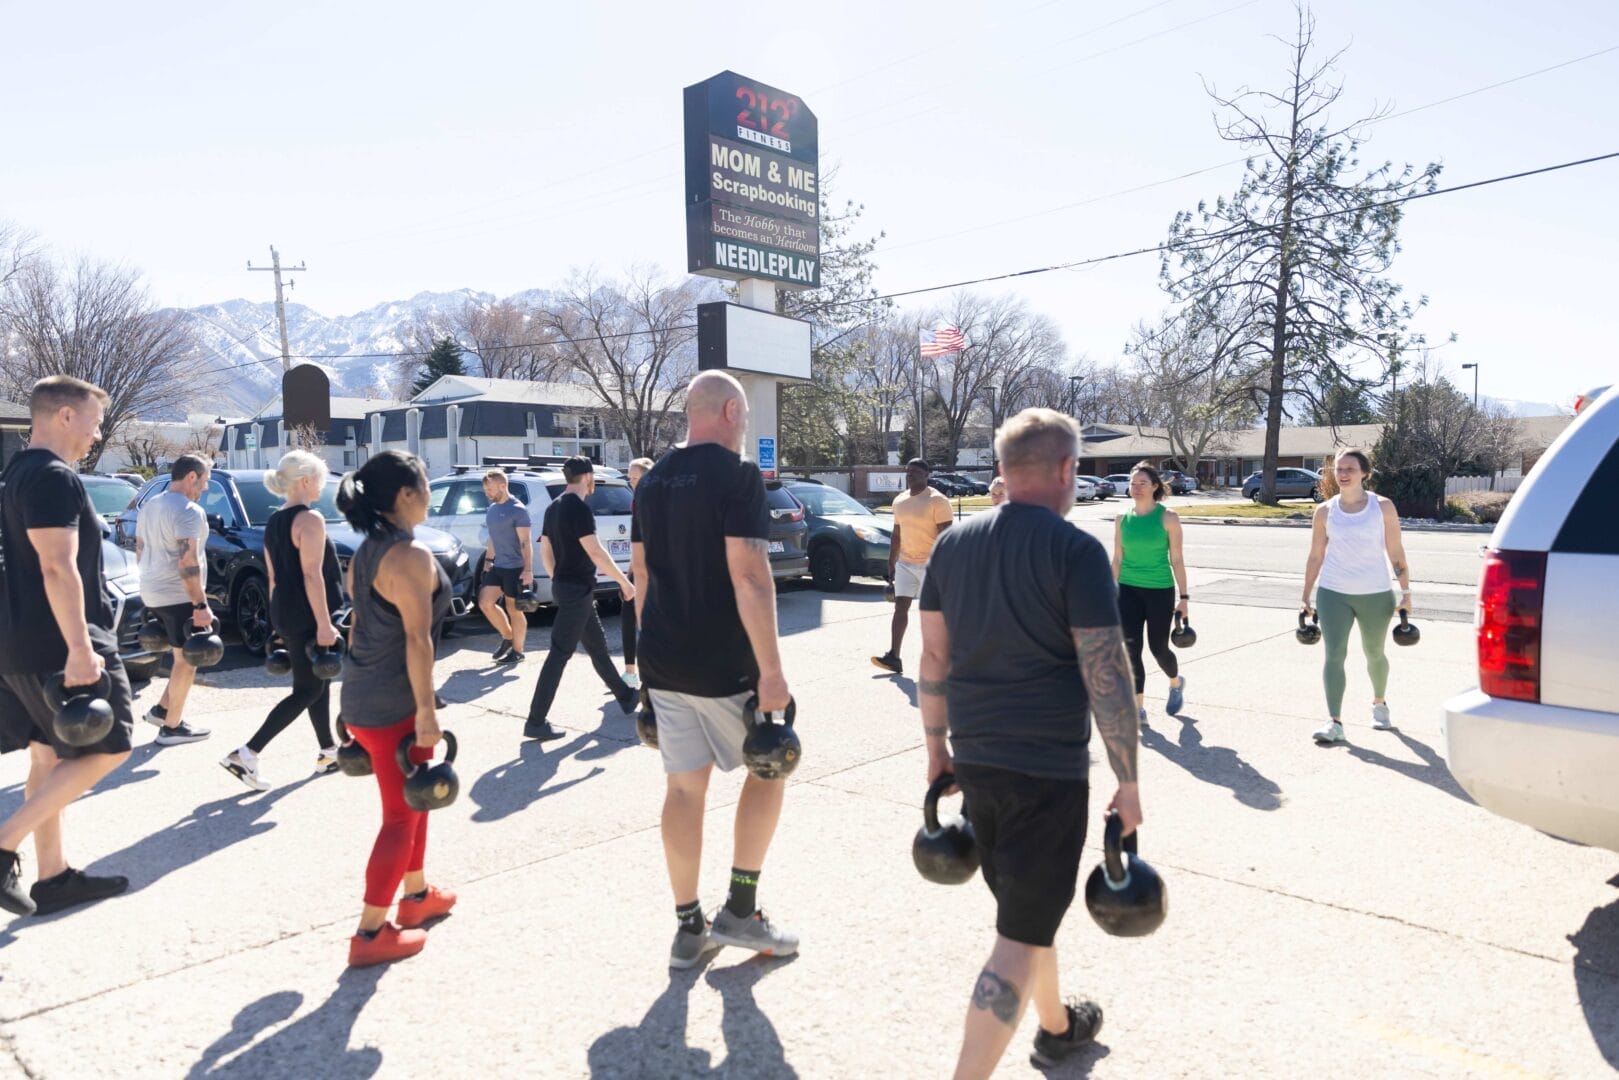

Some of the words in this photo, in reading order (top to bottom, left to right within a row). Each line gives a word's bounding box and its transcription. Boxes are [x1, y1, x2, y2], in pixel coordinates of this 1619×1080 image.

[738, 127, 790, 151] FITNESS
[711, 143, 760, 178] MOM
[767, 161, 782, 184] &
[788, 166, 815, 193] ME
[712, 172, 816, 218] Scrapbooking
[713, 221, 759, 242] becomes
[760, 235, 773, 245] an
[775, 235, 817, 254] Heirloom
[719, 208, 742, 224] The
[743, 215, 781, 236] Hobby
[783, 225, 807, 239] that
[715, 241, 815, 282] NEEDLEPLAY
